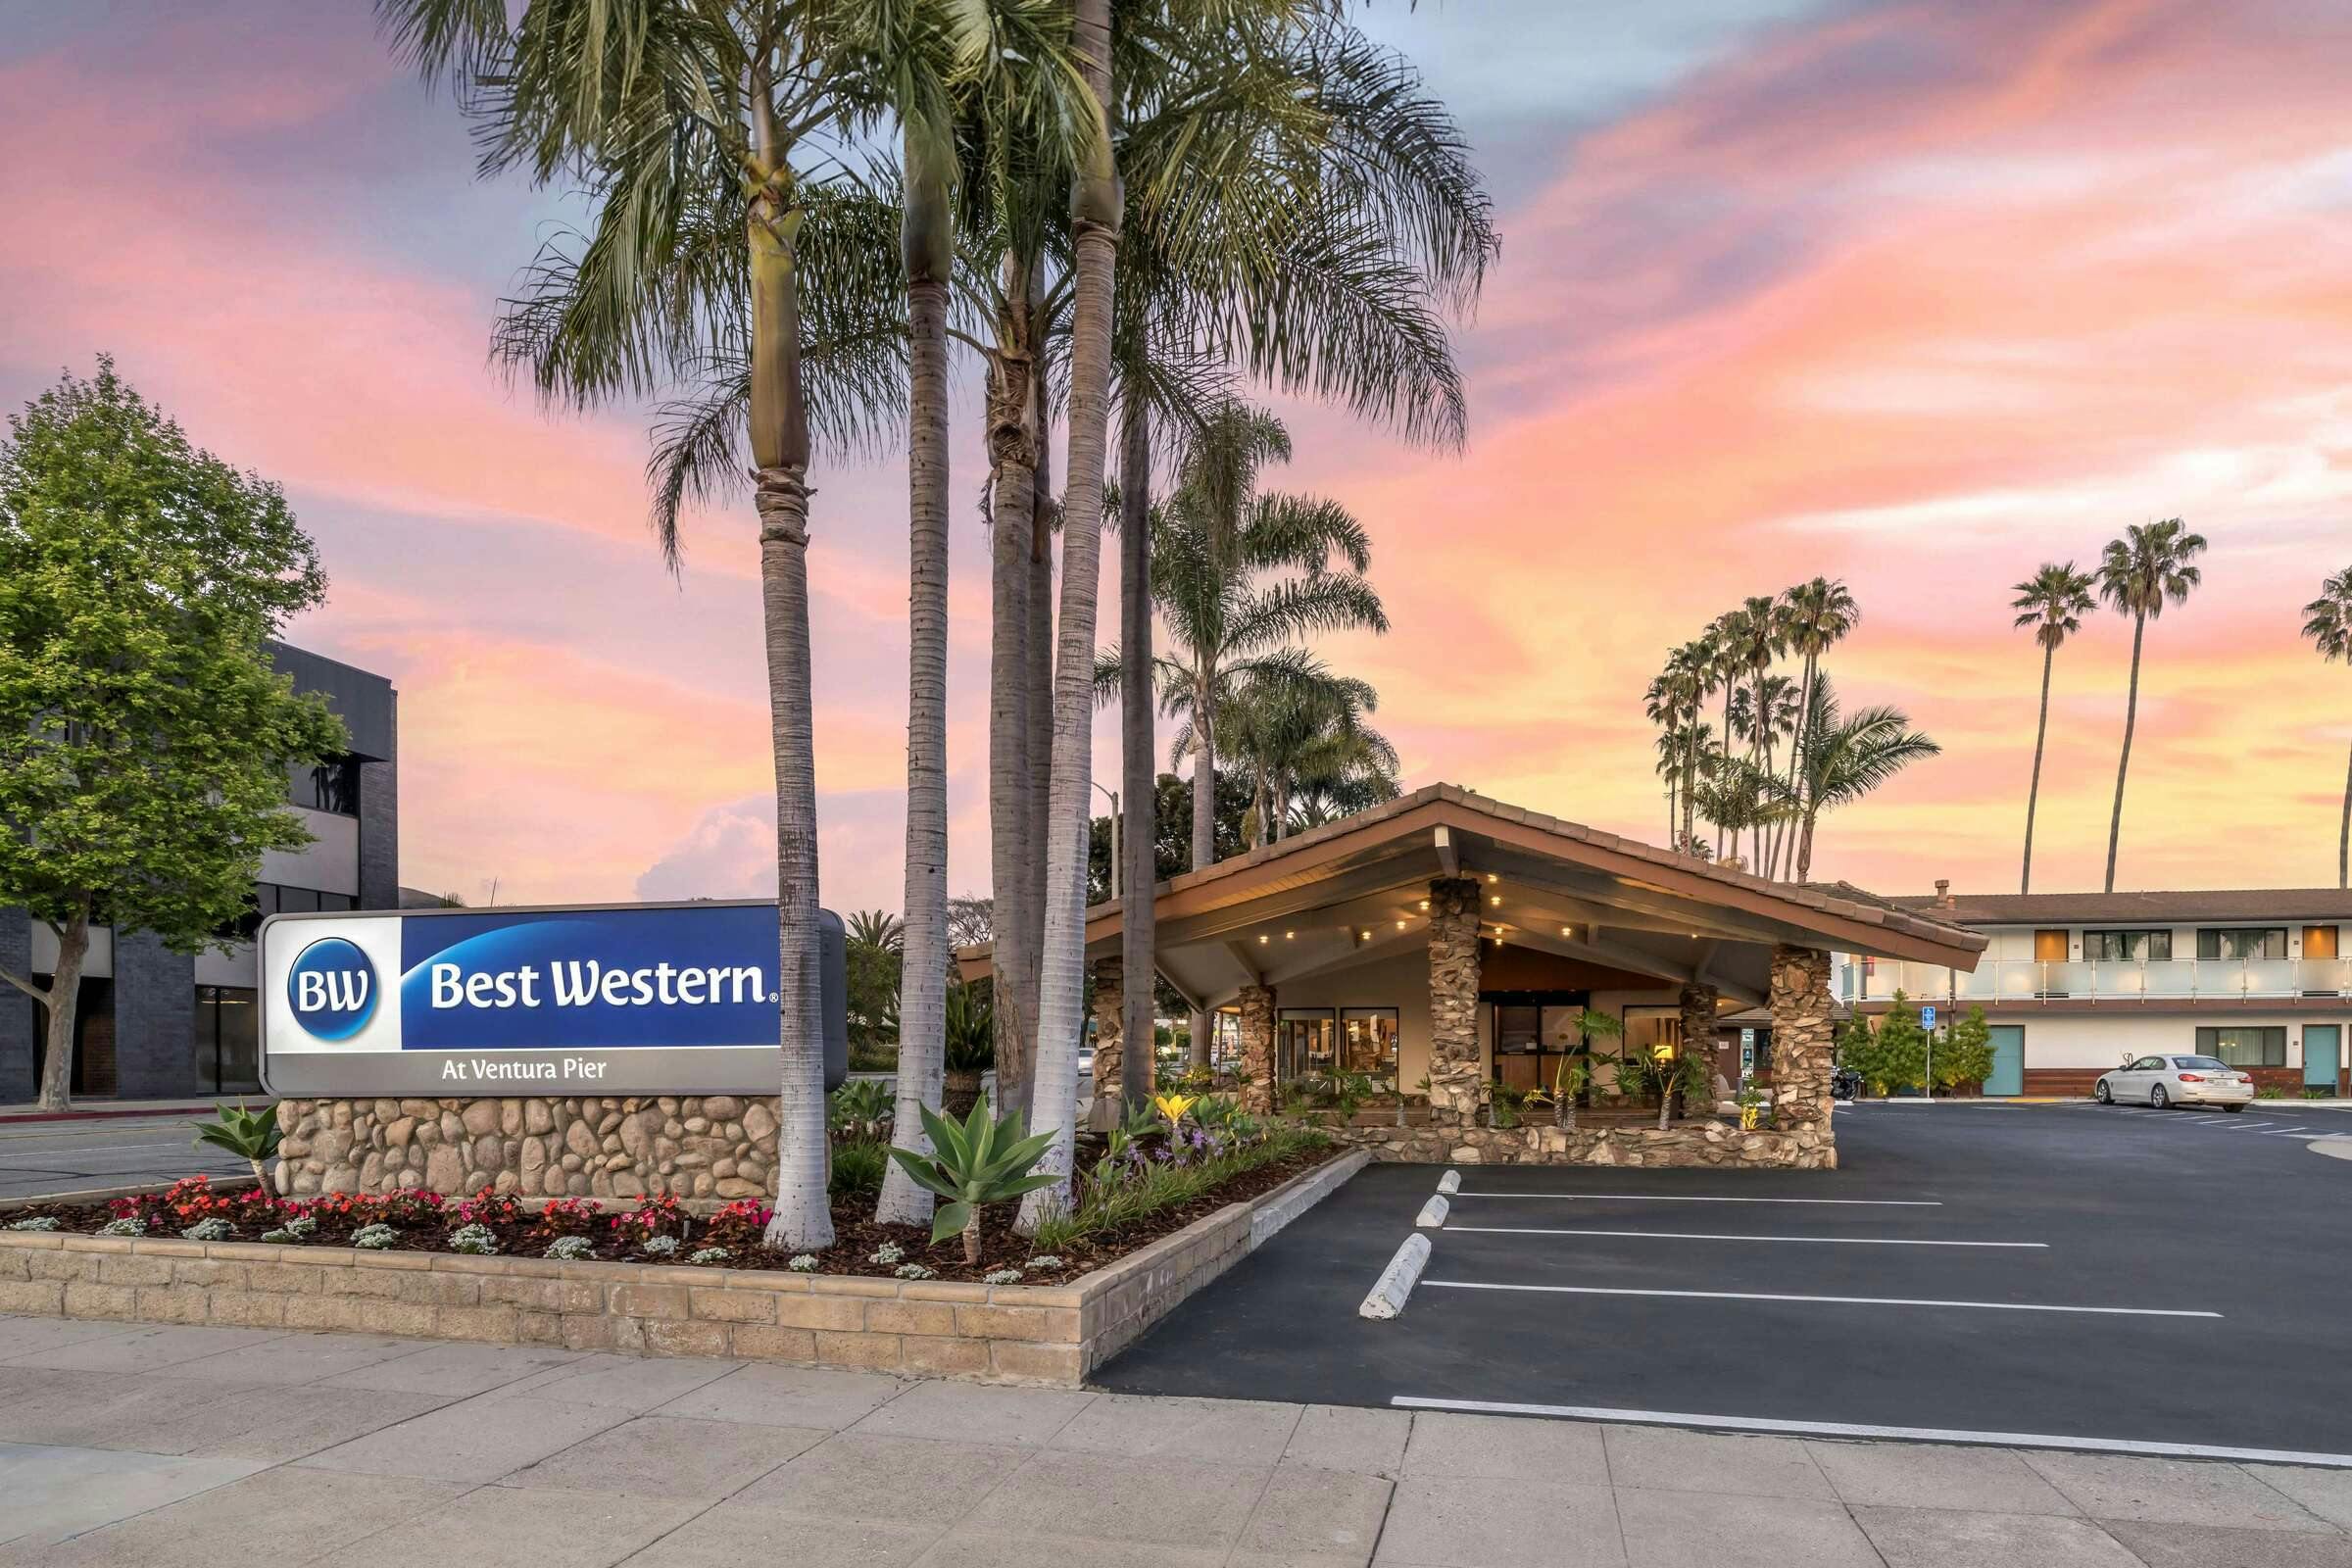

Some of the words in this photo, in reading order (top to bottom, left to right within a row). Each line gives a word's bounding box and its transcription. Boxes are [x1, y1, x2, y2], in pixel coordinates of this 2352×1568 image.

[299, 969, 368, 1011] BW
[431, 963, 541, 1008] Best
[442, 1059, 466, 1079] At
[471, 1058, 557, 1079] Ventura
[564, 1057, 607, 1078] Pier
